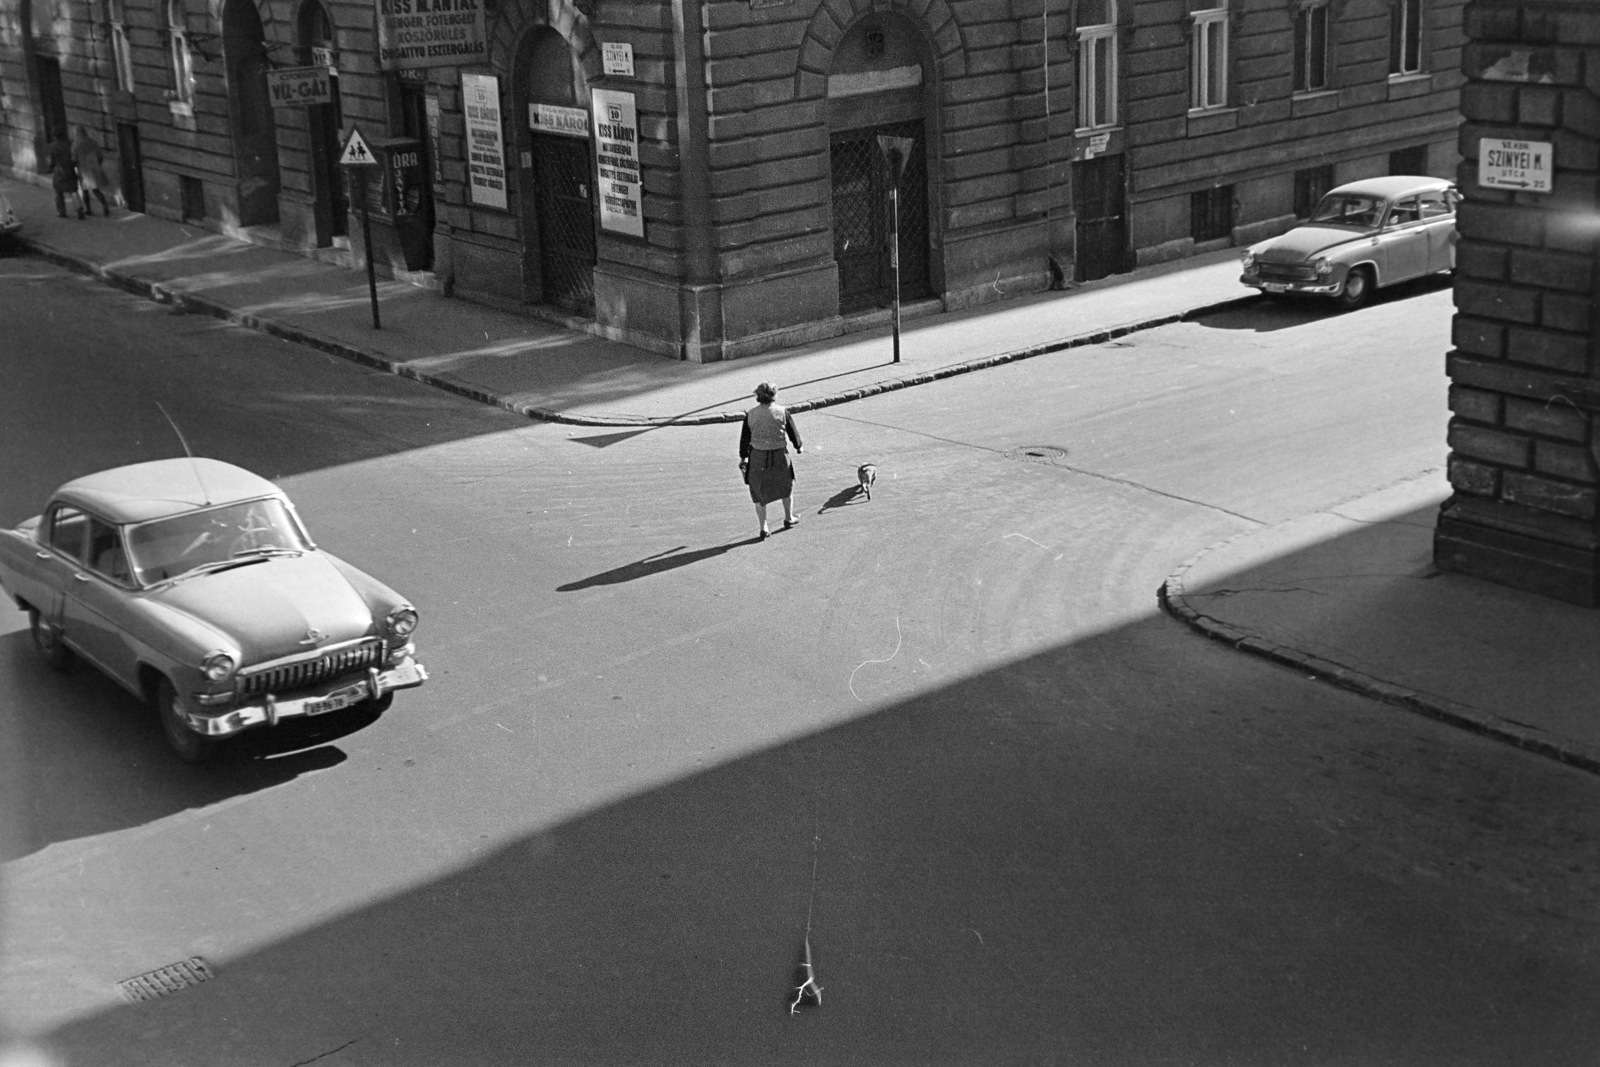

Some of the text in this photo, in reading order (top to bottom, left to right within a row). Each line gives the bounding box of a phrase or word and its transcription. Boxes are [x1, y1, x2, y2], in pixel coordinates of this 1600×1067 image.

[381, 0, 411, 14] KISS
[610, 110, 620, 119] 10
[598, 122, 634, 142] KISS KÁROLY
[392, 152, 418, 169] ÓRA
[1488, 150, 1530, 169] SZINYEI
[1502, 169, 1526, 178] UTCA
[1487, 176, 1545, 188] 12 20
